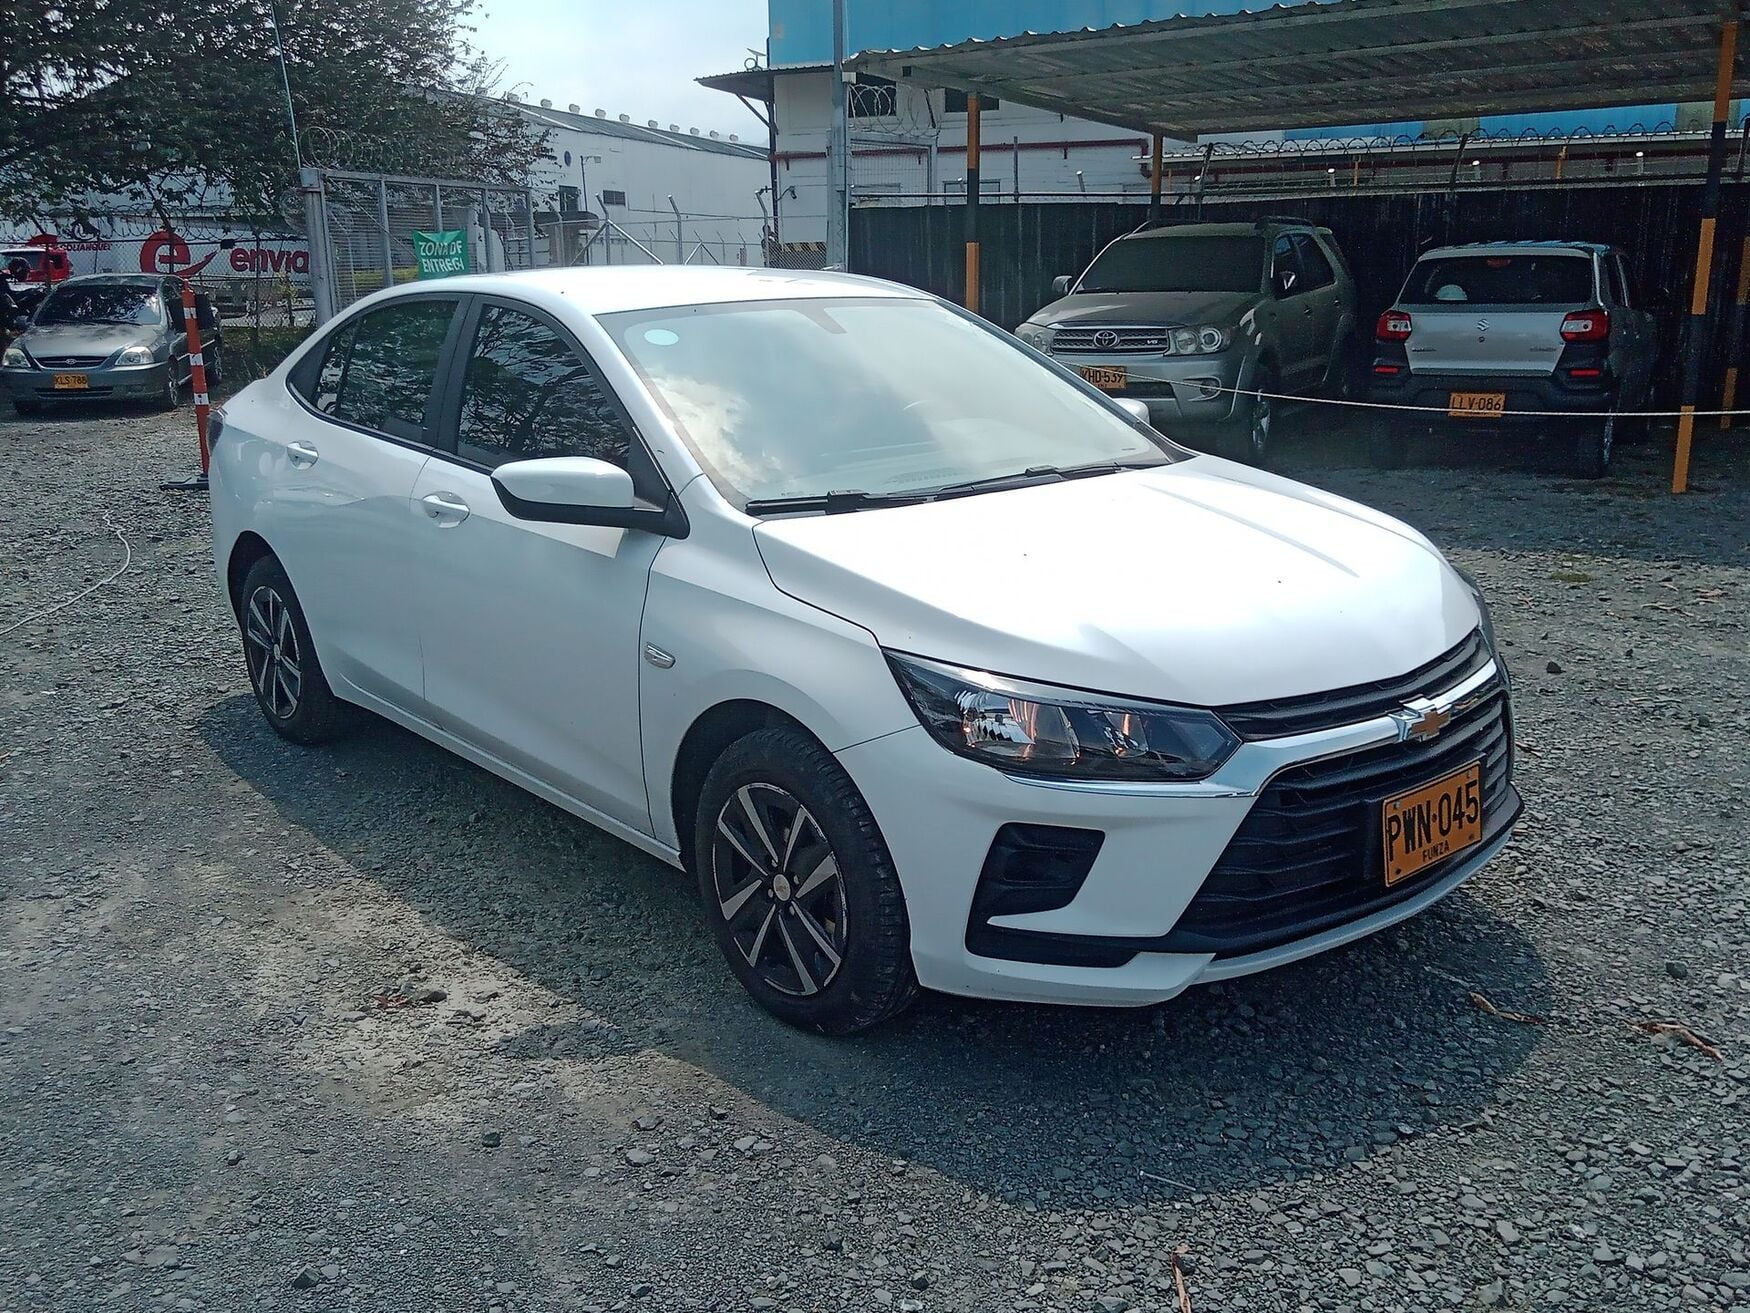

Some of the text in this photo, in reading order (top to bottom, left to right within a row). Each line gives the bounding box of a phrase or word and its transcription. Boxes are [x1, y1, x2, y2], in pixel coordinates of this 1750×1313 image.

[418, 240, 462, 256] ZONA DE
[1422, 840, 1450, 862] FUNZA
